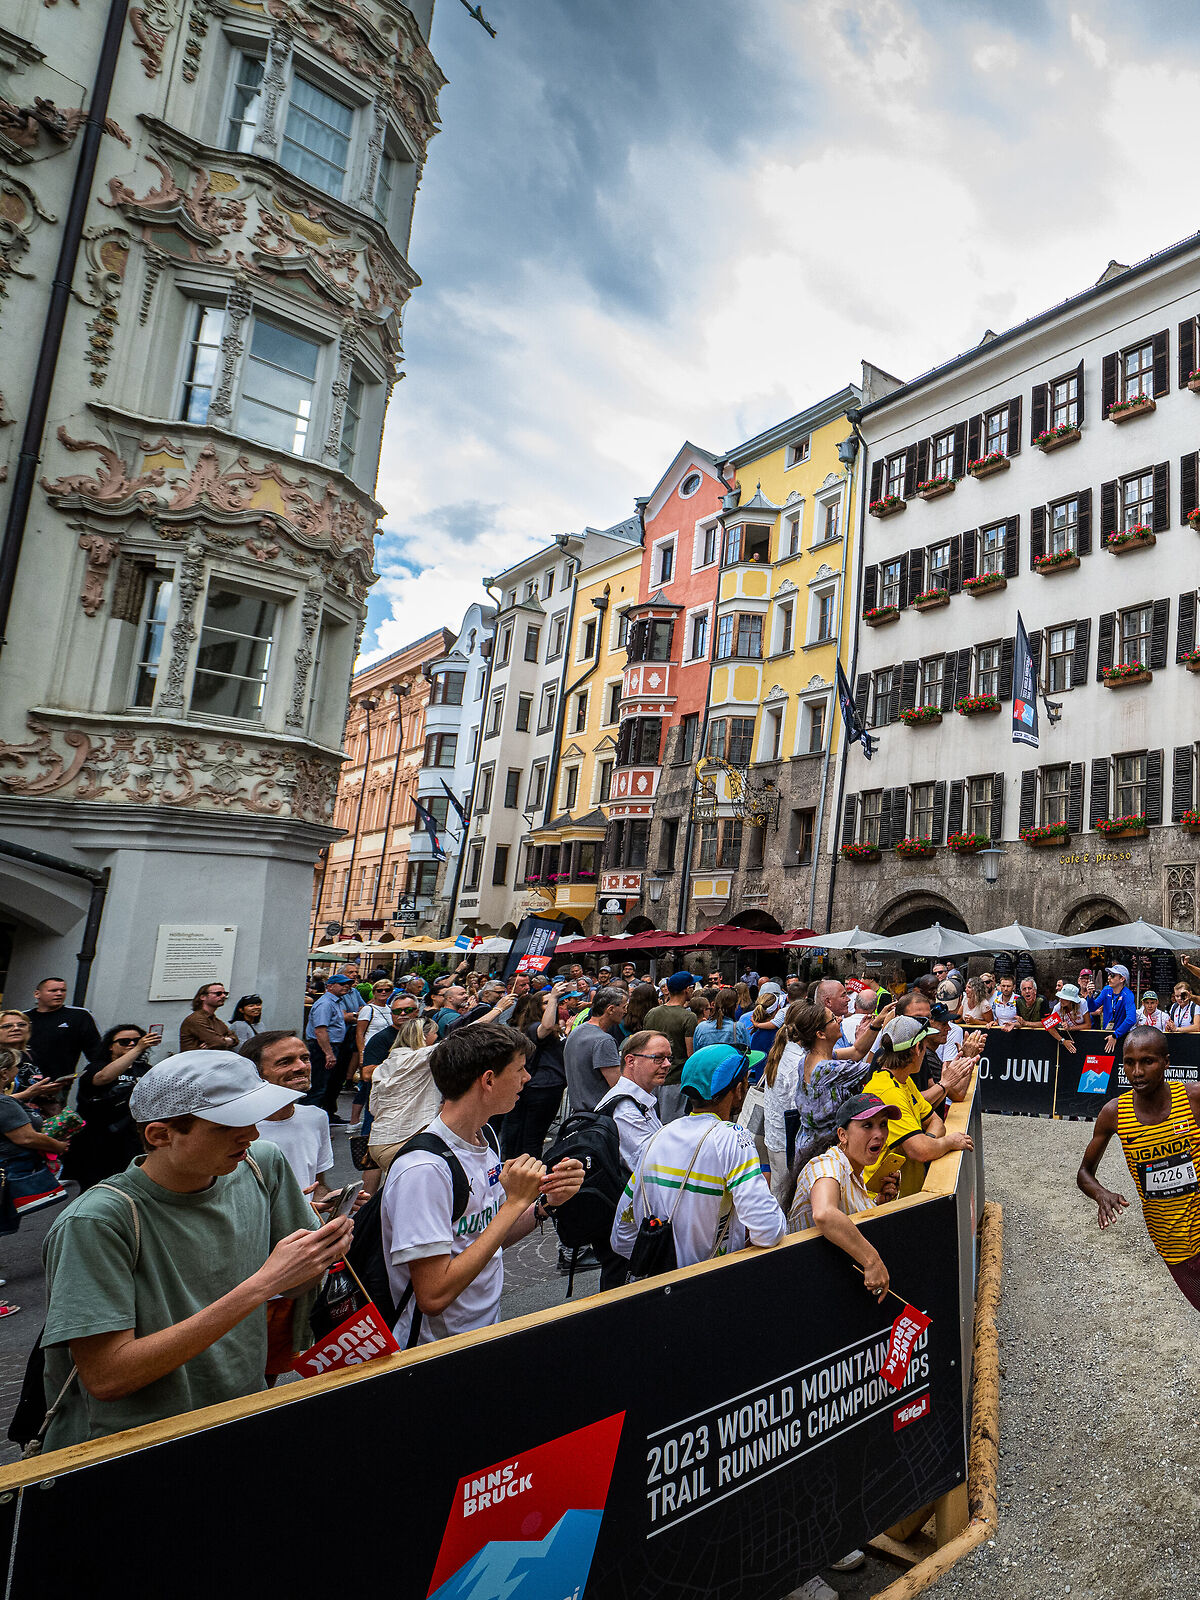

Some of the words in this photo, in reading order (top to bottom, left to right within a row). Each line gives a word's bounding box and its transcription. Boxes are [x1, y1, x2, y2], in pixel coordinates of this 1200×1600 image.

[1083, 852, 1131, 864] Epresso
[1000, 1058, 1050, 1083] JUNI
[1164, 1069, 1185, 1078] UNTAIN
[1185, 1070, 1199, 1079] AND
[1130, 1138, 1192, 1161] UGANDA
[1152, 1167, 1183, 1184] 4226
[885, 1316, 913, 1376] BRUCK
[646, 1424, 710, 1486] 2023
[717, 1385, 794, 1450] WORLD
[801, 1340, 891, 1410] MOUNTAIN
[897, 1398, 927, 1423] Tirol
[463, 1461, 519, 1501] INNS'
[646, 1465, 711, 1522] TRAIL
[718, 1418, 801, 1487] RUNNING
[463, 1473, 533, 1518] BRUCK
